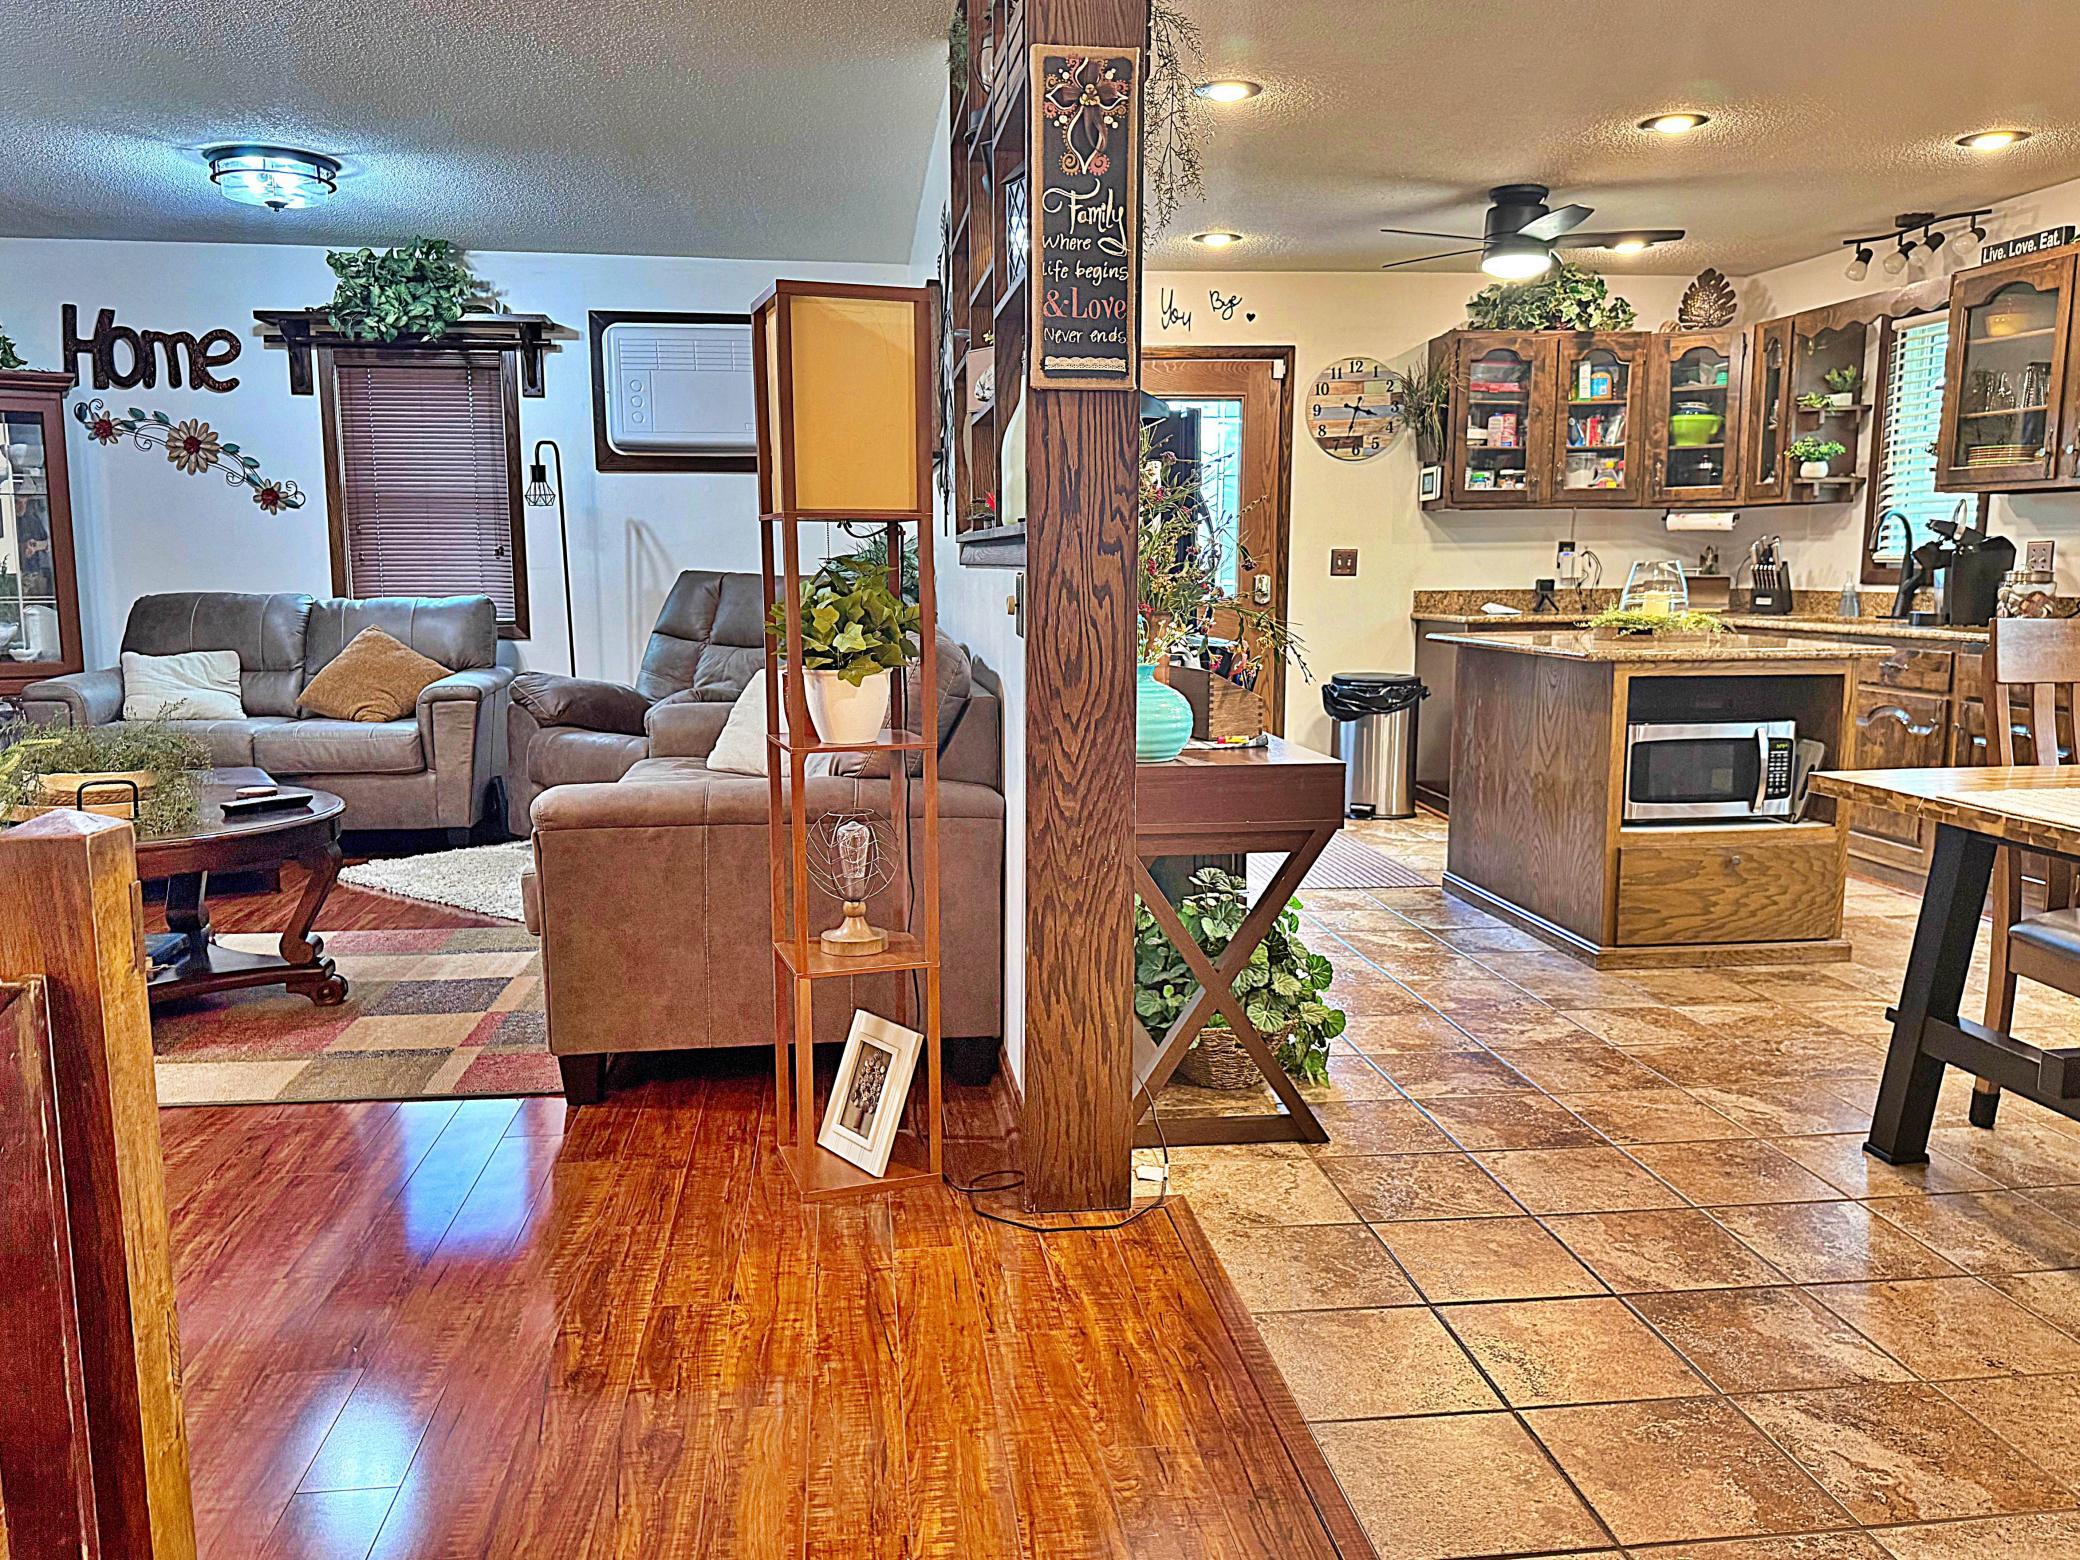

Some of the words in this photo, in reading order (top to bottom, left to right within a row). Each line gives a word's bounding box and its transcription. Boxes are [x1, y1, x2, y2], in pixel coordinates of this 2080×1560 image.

[1042, 179, 1128, 257] Family
[1982, 246, 2007, 263] Live.
[2008, 239, 2037, 257] Love.
[1074, 260, 1129, 286] begins
[1043, 327, 1083, 343] Never
[1089, 326, 1127, 343] ends
[62, 303, 242, 394] Home
[1330, 367, 1342, 379] 11
[1350, 360, 1363, 373] 12
[1373, 365, 1378, 377] 1
[1315, 382, 1330, 395] 10
[1386, 379, 1394, 392] 2
[1313, 404, 1321, 416] 9
[1391, 401, 1399, 413] 3
[1318, 424, 1327, 437] 8
[1385, 421, 1393, 433] 4
[1332, 438, 1340, 451] 7
[1371, 437, 1379, 449] 5
[1352, 444, 1360, 456] 6
